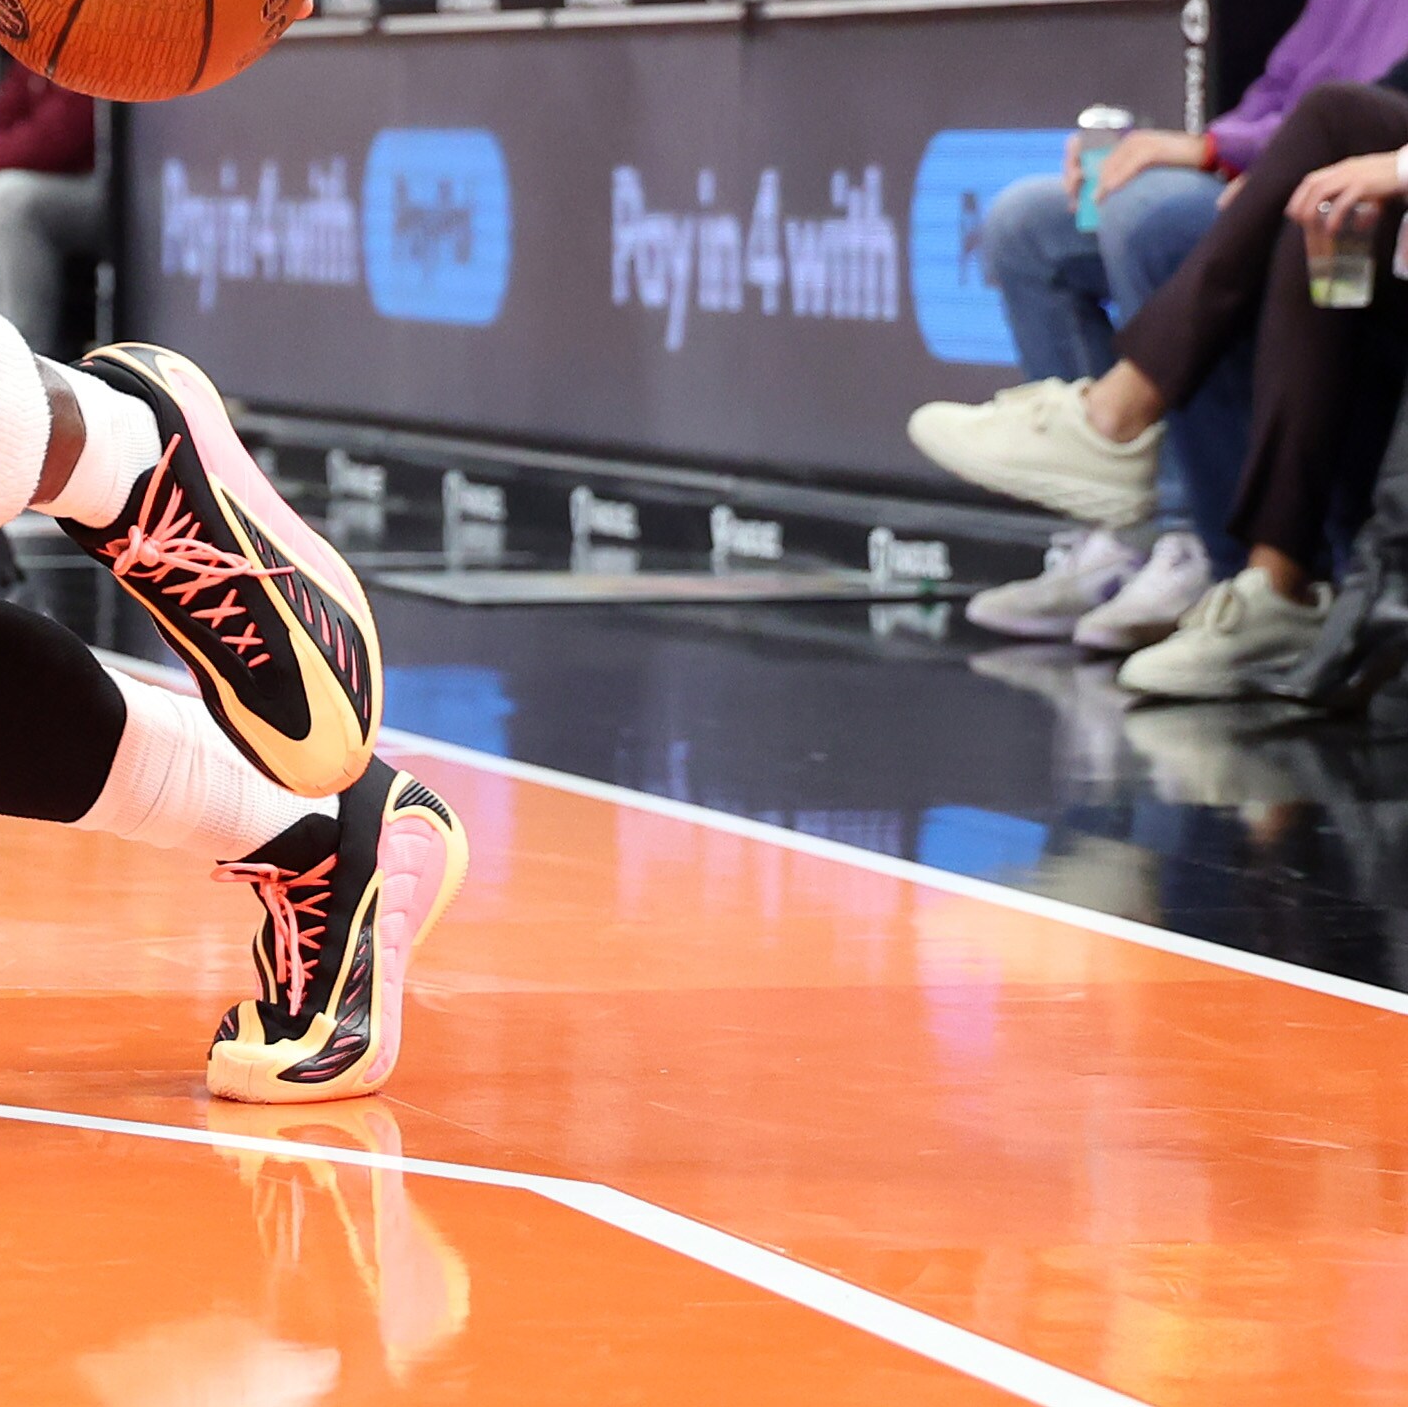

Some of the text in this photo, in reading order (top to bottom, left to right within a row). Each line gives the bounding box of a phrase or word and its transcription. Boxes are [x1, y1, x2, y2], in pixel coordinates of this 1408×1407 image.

[611, 164, 691, 352] Pay
[697, 166, 744, 313] in
[746, 167, 784, 316] 4
[786, 163, 900, 323] with
